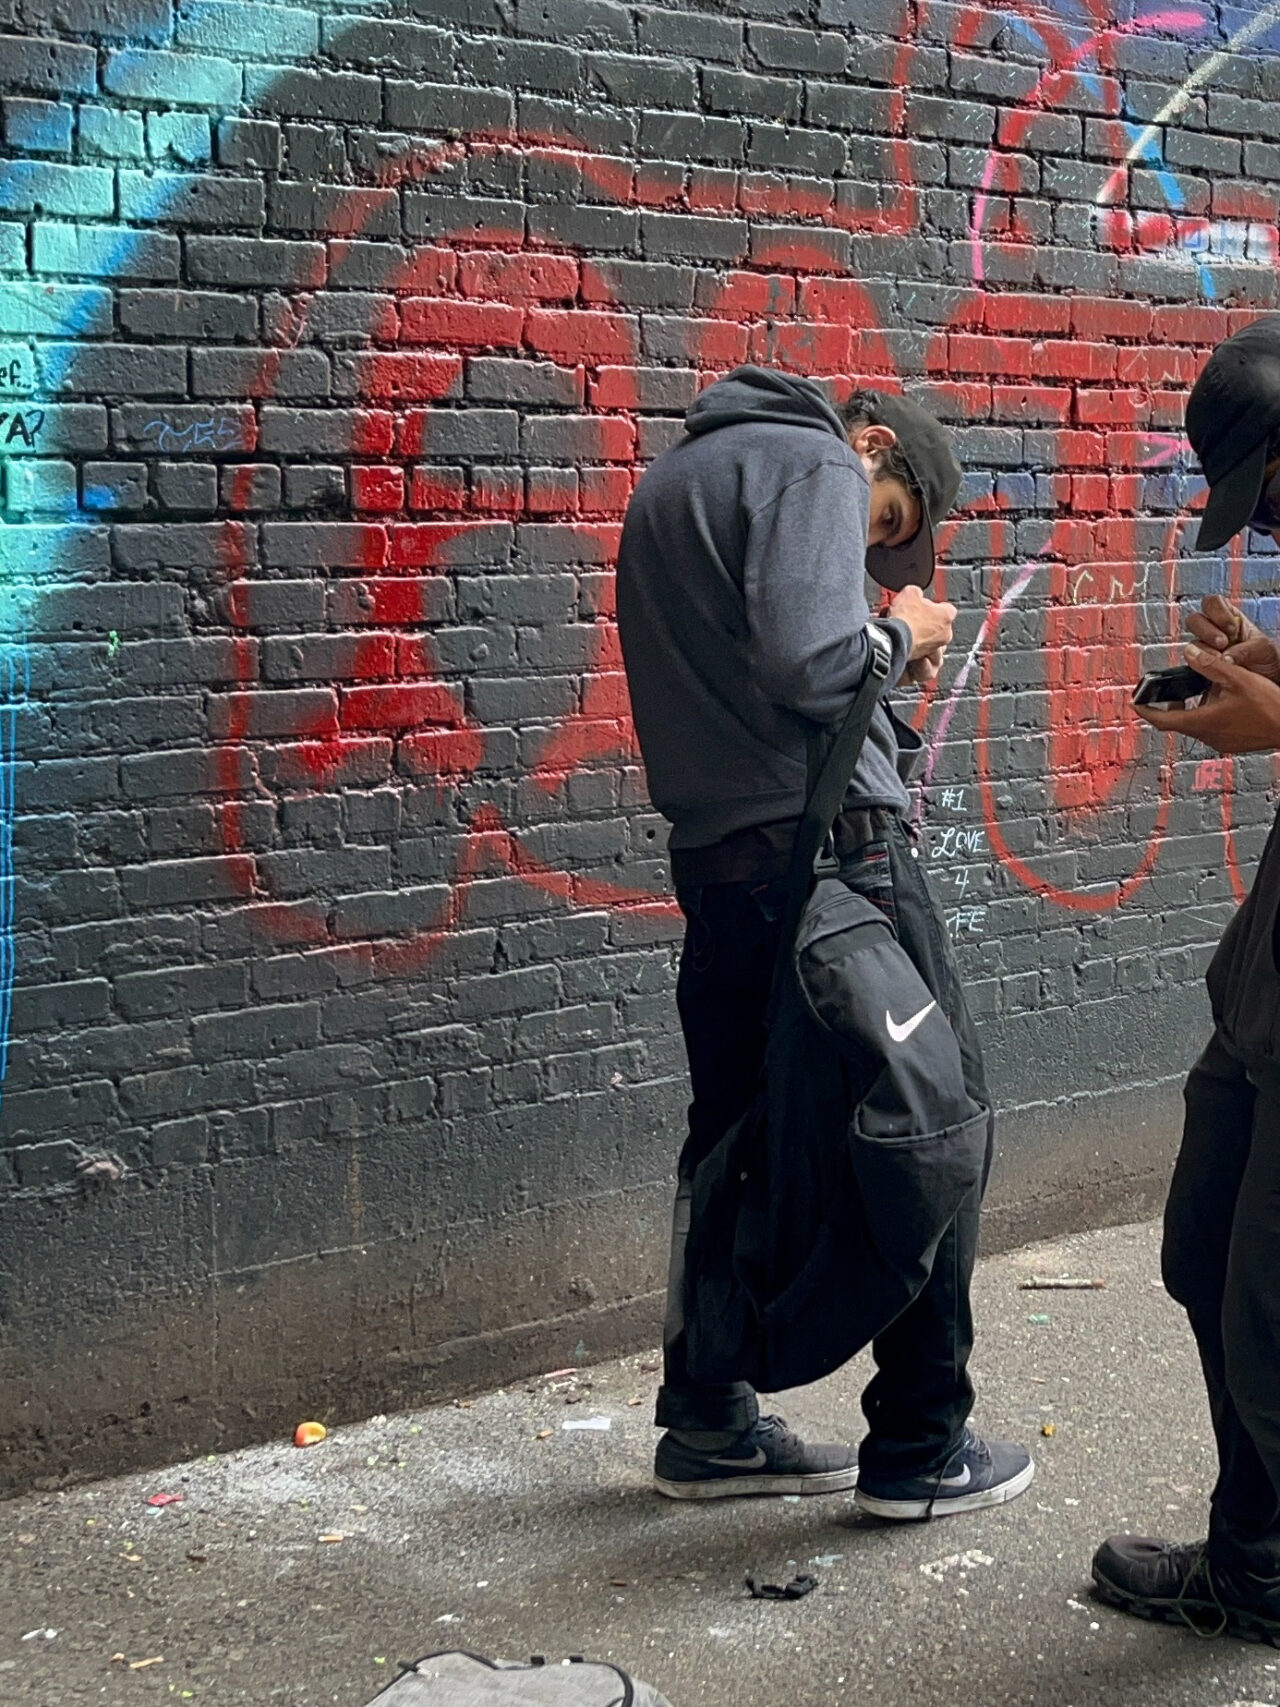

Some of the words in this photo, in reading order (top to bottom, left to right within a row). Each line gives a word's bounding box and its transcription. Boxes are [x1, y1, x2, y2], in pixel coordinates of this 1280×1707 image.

[941, 788, 968, 811] #1
[931, 827, 990, 858] LOVE
[955, 869, 970, 899] 4
